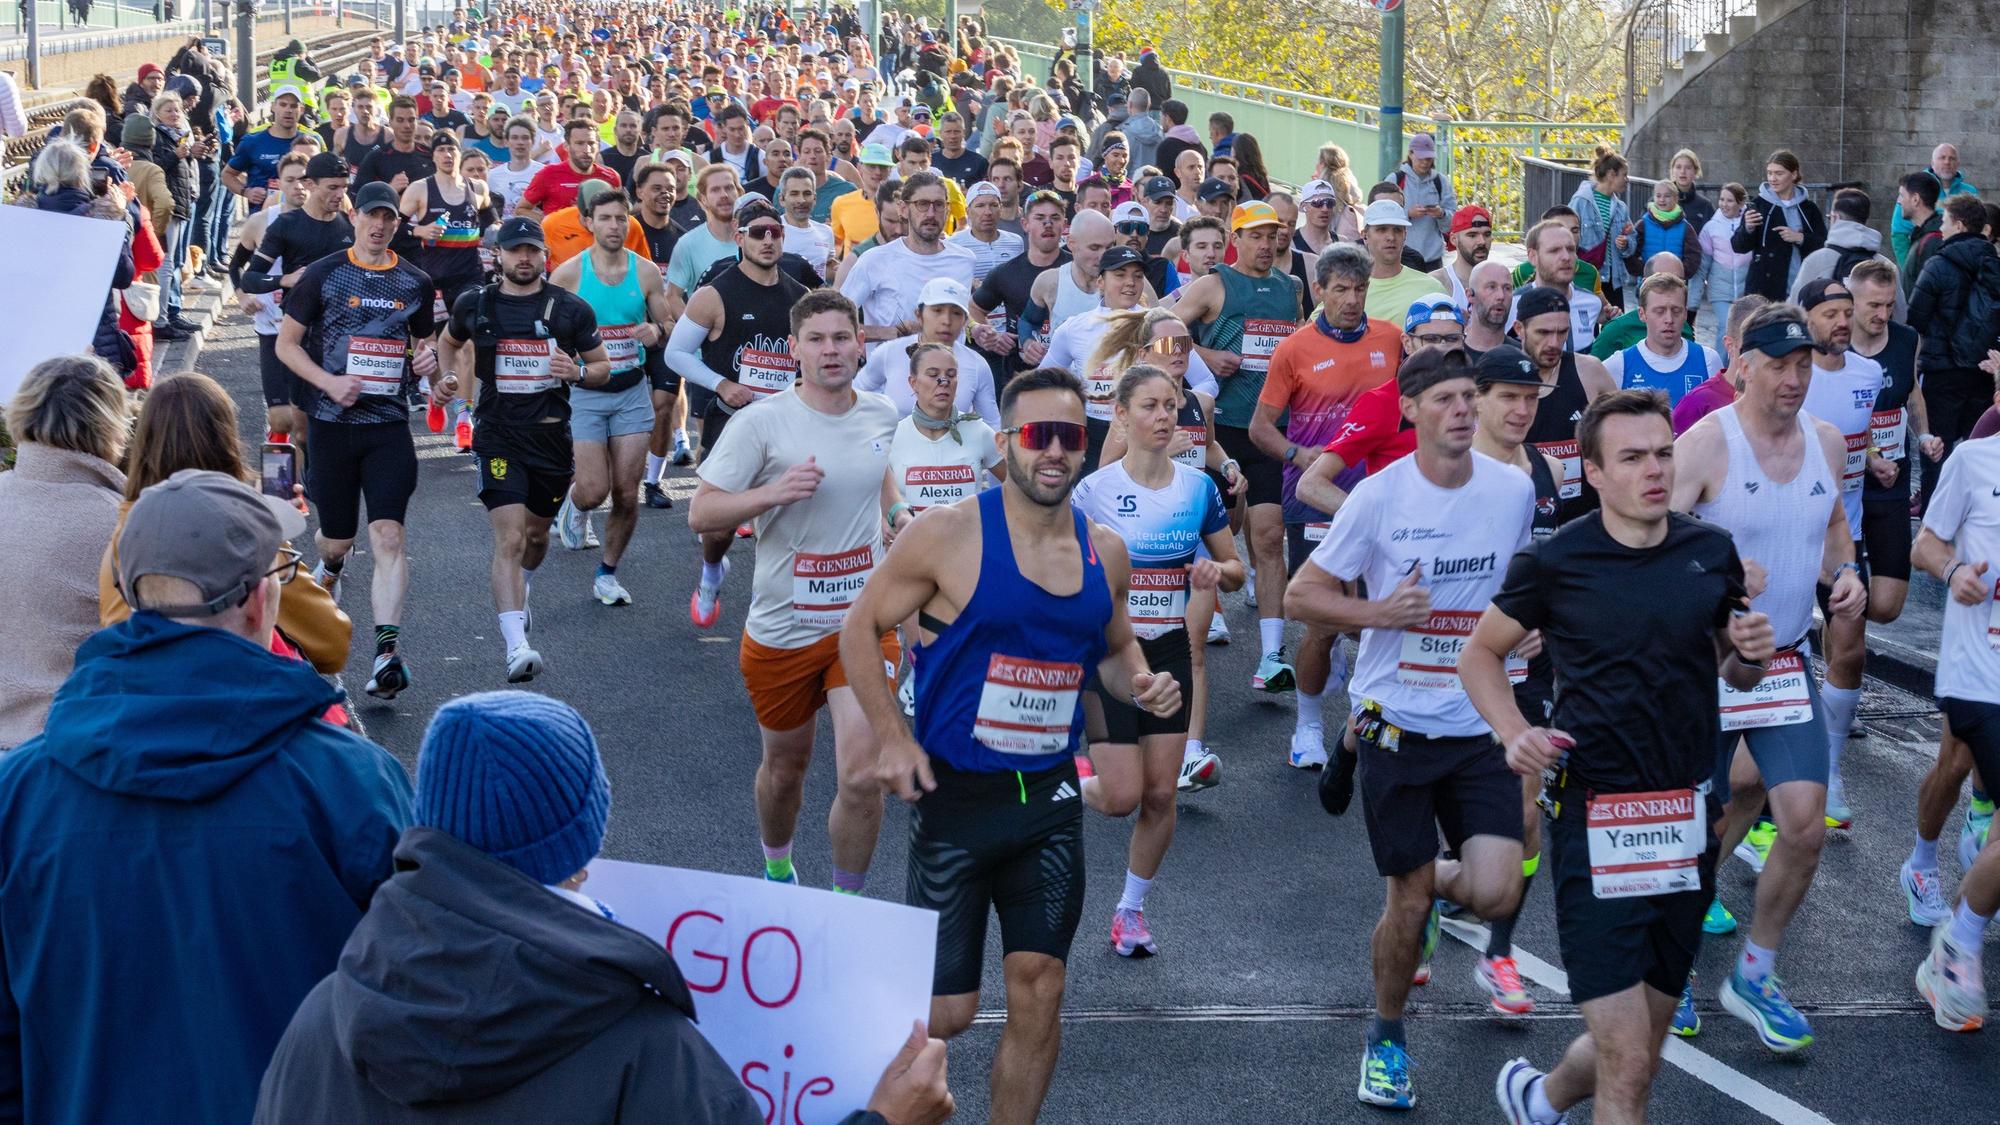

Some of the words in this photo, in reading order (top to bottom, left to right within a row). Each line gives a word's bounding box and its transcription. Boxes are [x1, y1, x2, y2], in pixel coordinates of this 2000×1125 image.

[361, 298, 405, 310] motoin
[364, 341, 405, 354] GENERALI
[505, 342, 548, 354] GENERALI
[605, 340, 635, 351] omas
[1254, 336, 1280, 348] Julia
[352, 356, 402, 369] Sebastian
[504, 357, 540, 368] Flavio
[757, 355, 796, 368] GENERALI
[749, 367, 789, 383] Patrick
[922, 468, 973, 481] GENERALI
[919, 486, 963, 498] Alexia
[1136, 541, 1185, 551] NeckarAlb
[816, 552, 871, 573] GENERALI
[1433, 551, 1497, 576] bunert
[808, 576, 865, 594] Marius
[1130, 573, 1185, 586] GENERALI
[1129, 592, 1173, 607] sabel
[1430, 616, 1478, 631] GENER
[1420, 636, 1465, 653] Stefa
[1016, 666, 1081, 687] GENERALI
[1724, 677, 1801, 694] Sastian
[1009, 691, 1057, 712] Juan
[1613, 797, 1693, 819] GENERALI
[1605, 825, 1685, 849] Yannik
[665, 910, 803, 1008] GO
